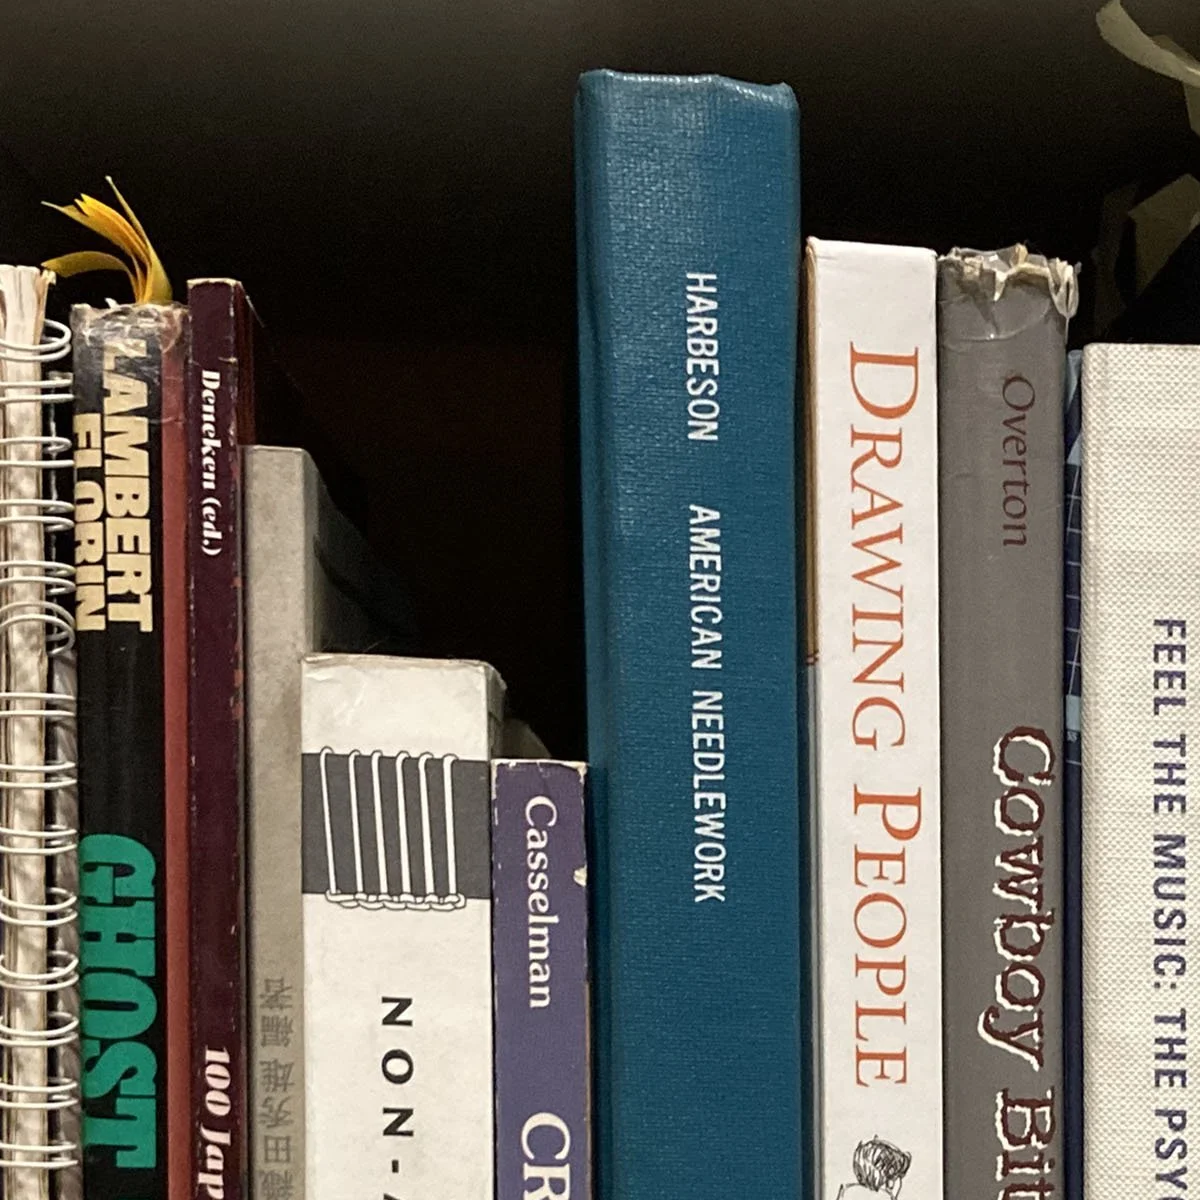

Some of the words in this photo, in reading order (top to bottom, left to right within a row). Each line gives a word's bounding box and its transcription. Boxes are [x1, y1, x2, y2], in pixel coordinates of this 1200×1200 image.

[199, 368, 222, 492] Deneken
[685, 271, 721, 442] HARBESON
[102, 337, 153, 633] LAMBERT
[200, 495, 223, 557] (ed.)
[848, 340, 920, 752] DRAWING
[1000, 374, 1036, 548] Overton
[688, 502, 723, 671] AMERICAN
[1152, 618, 1188, 717] FEEL
[691, 689, 727, 904] NEEDLEWORK
[1152, 733, 1188, 816] THE
[523, 795, 560, 1010] Casselman
[851, 782, 923, 1088] PEOPLE
[976, 724, 1057, 1073] Cowboy
[1153, 833, 1188, 991] MUSIC:
[79, 833, 158, 1169] GHOST
[203, 1044, 232, 1116] 100
[1153, 1007, 1189, 1089] THE
